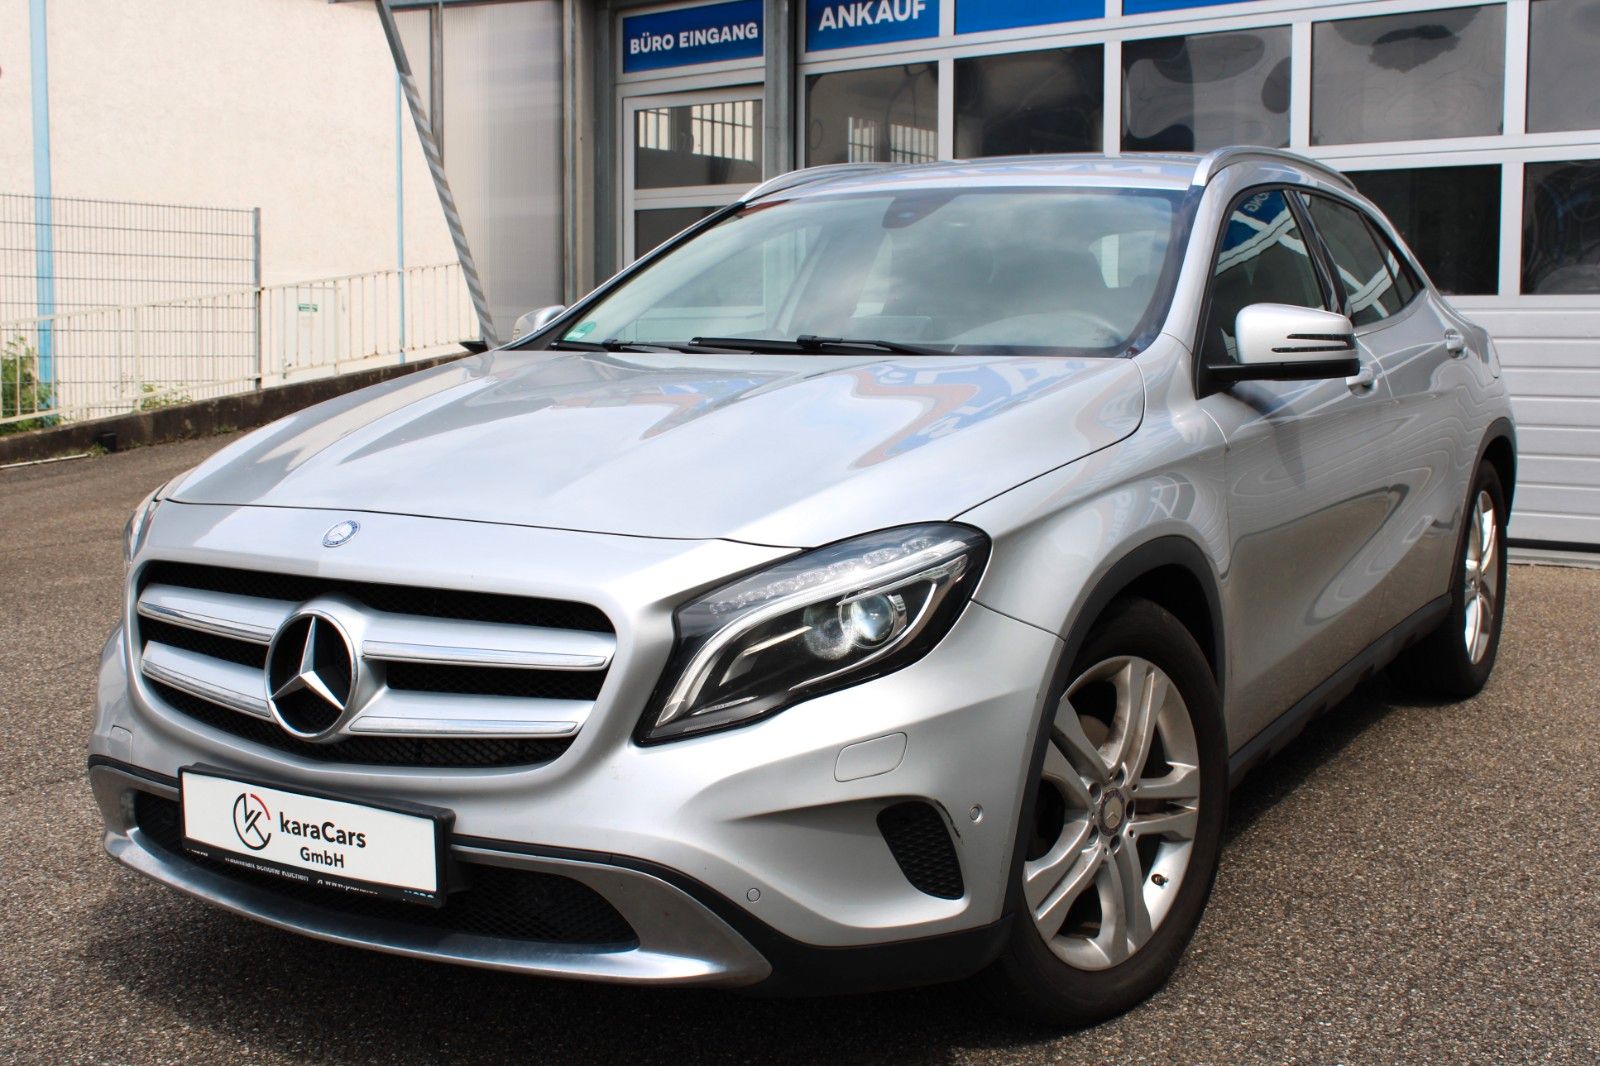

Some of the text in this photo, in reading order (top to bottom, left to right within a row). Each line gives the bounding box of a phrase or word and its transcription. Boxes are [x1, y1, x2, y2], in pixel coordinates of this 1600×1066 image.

[818, 0, 926, 31] ANKAUF
[630, 22, 758, 55] BÜRO EINGANG
[279, 811, 367, 848] karaCars
[300, 846, 344, 868] GmbH
